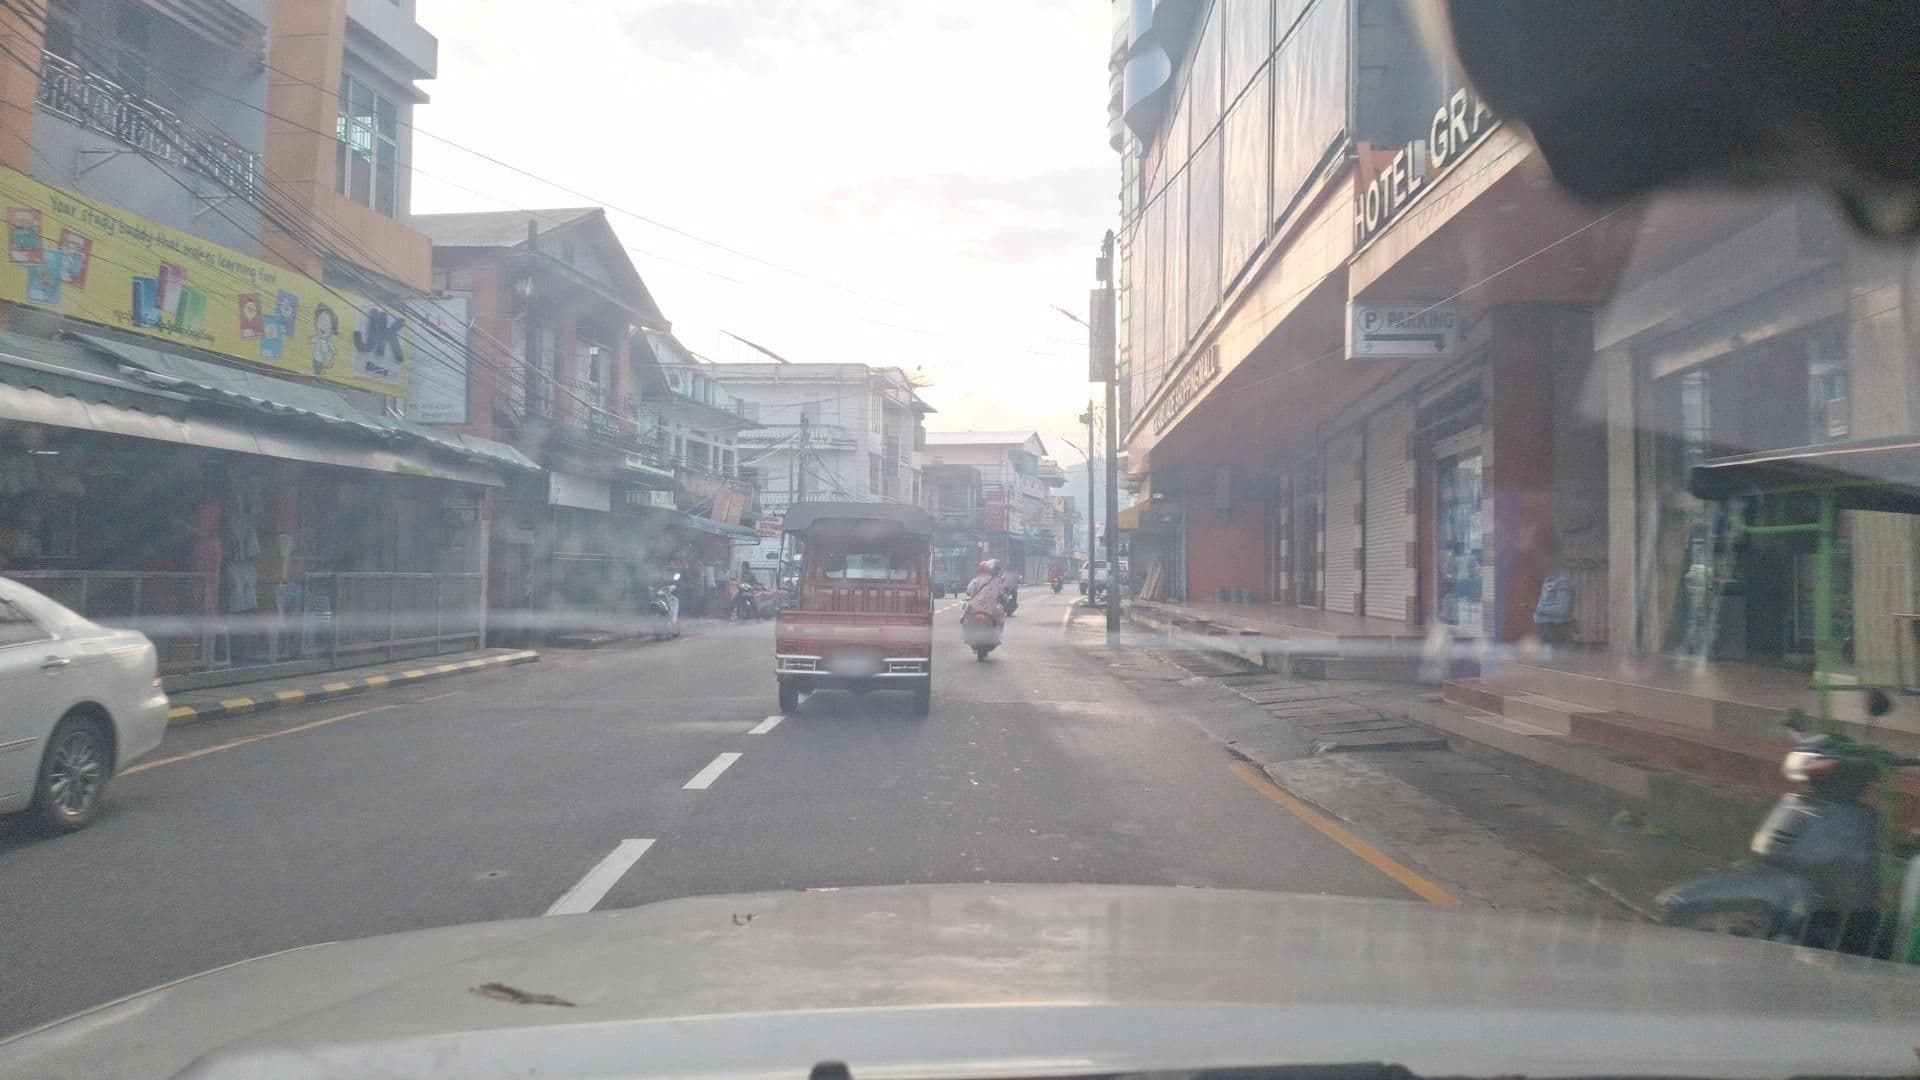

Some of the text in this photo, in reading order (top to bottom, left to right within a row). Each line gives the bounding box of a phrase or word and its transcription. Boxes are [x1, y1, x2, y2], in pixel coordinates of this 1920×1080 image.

[1354, 140, 1421, 247] HOTEL
[50, 194, 76, 216] Your
[81, 208, 115, 236] study
[119, 219, 152, 249] buddy
[155, 230, 180, 250] that
[183, 241, 216, 265] makes
[217, 253, 256, 285] learning
[353, 308, 405, 362] JK
[1388, 311, 1454, 329] PARKING
